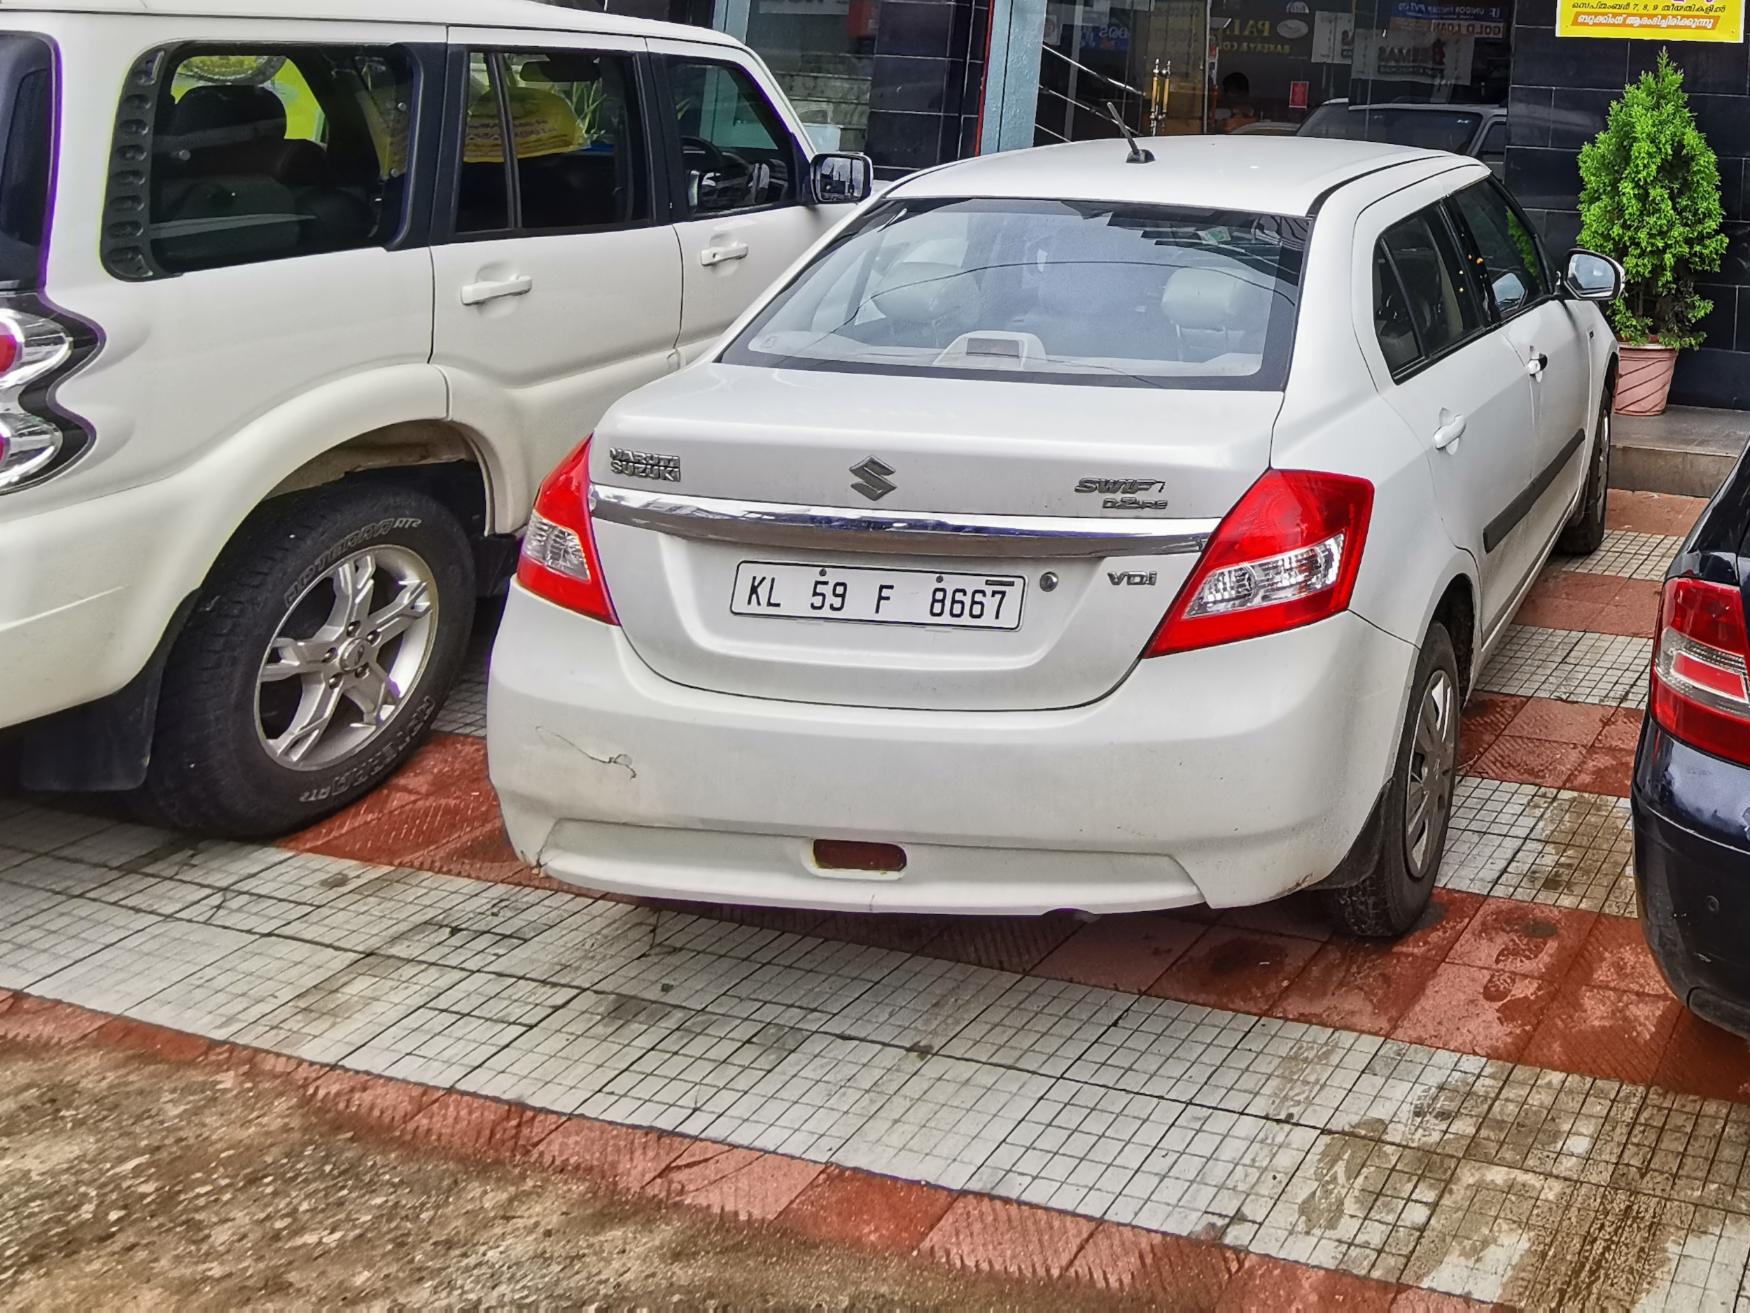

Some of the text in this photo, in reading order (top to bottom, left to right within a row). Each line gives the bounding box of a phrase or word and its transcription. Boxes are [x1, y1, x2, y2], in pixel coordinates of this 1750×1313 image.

[611, 459, 681, 483] SUZUKI
[747, 576, 1007, 620] KL 59 F 8667
